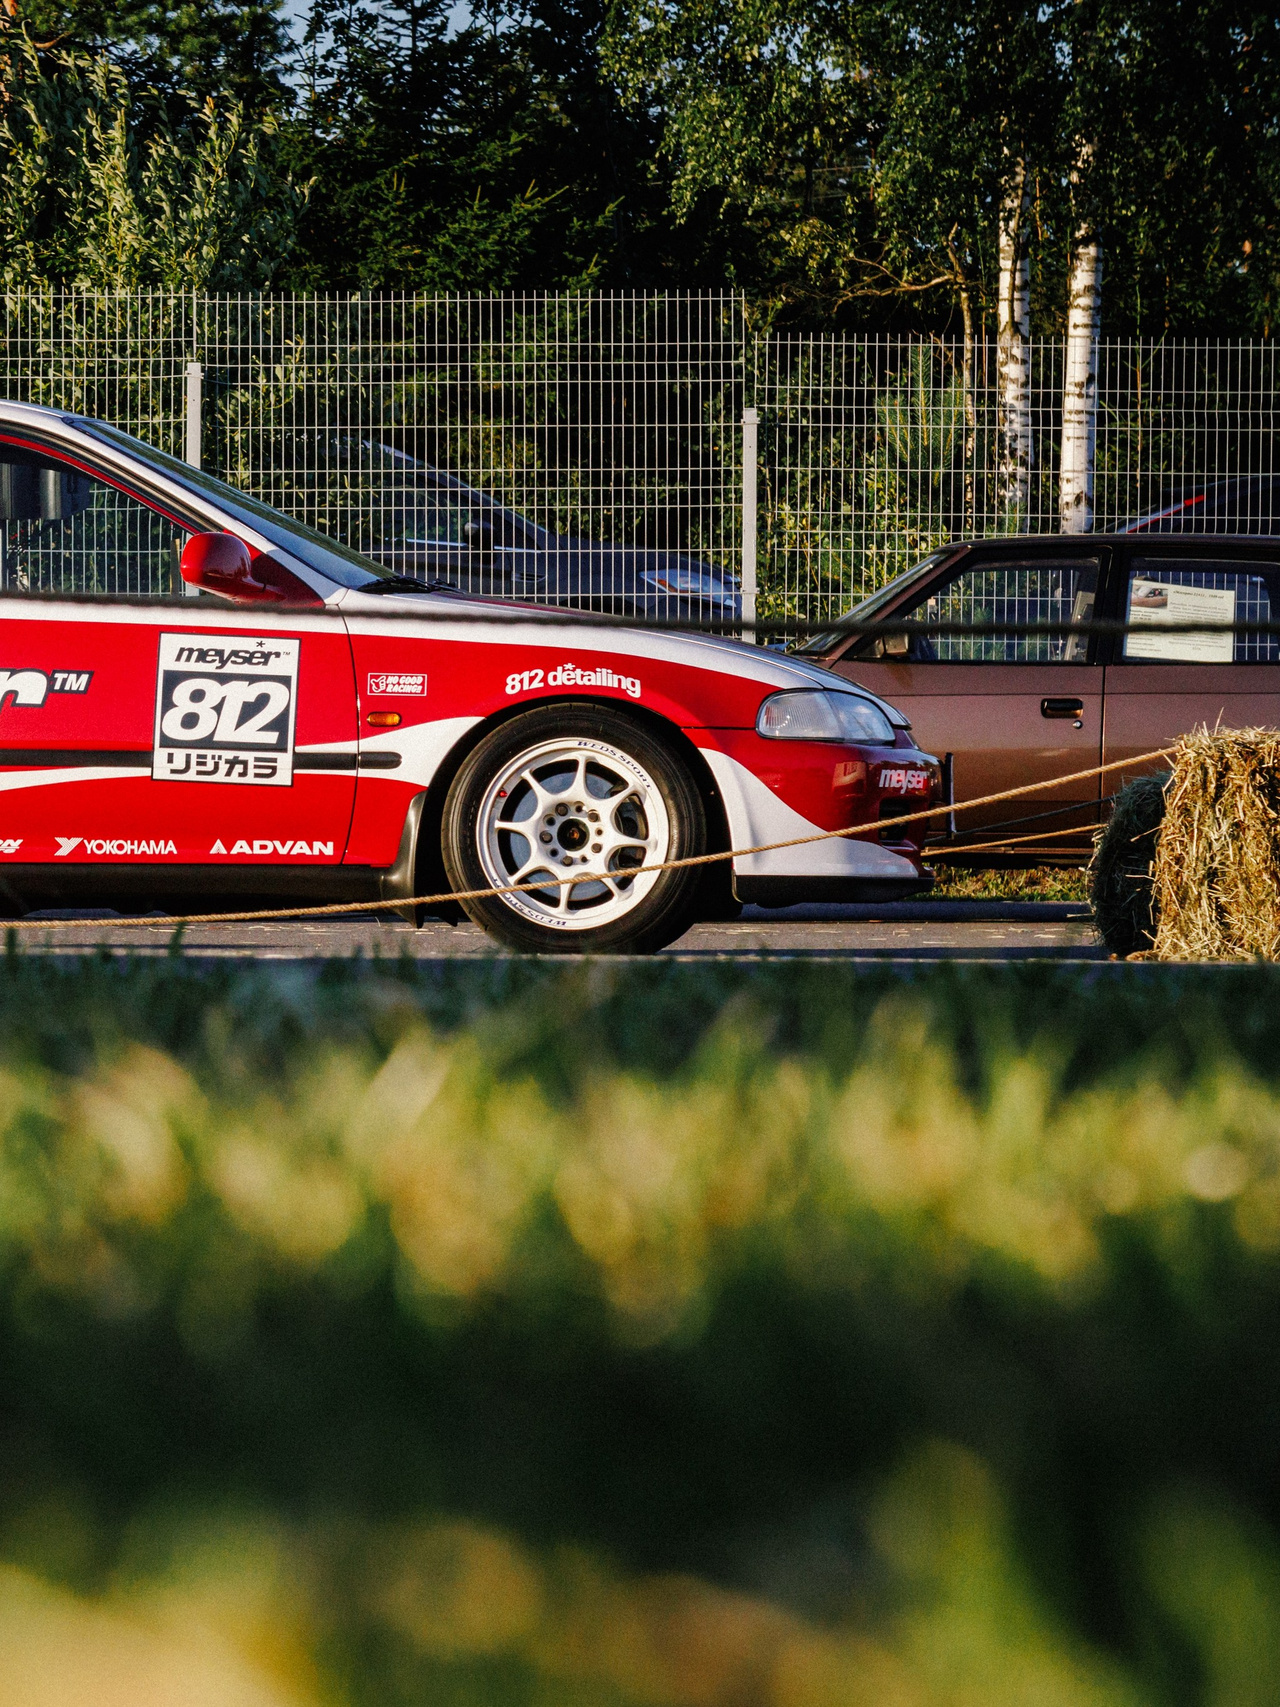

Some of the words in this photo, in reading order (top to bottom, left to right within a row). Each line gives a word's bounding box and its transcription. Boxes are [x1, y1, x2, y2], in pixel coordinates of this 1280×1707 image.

[386, 676, 399, 684] NO
[399, 676, 423, 685] GOOD
[505, 668, 544, 695] 812
[161, 678, 290, 744] 812
[167, 752, 278, 779] リジカラ
[577, 741, 617, 757] WEDS
[618, 755, 653, 790] SPORT
[879, 769, 928, 794] meyser
[83, 838, 178, 855] YOKOHAMA
[230, 839, 334, 856] ADVAN
